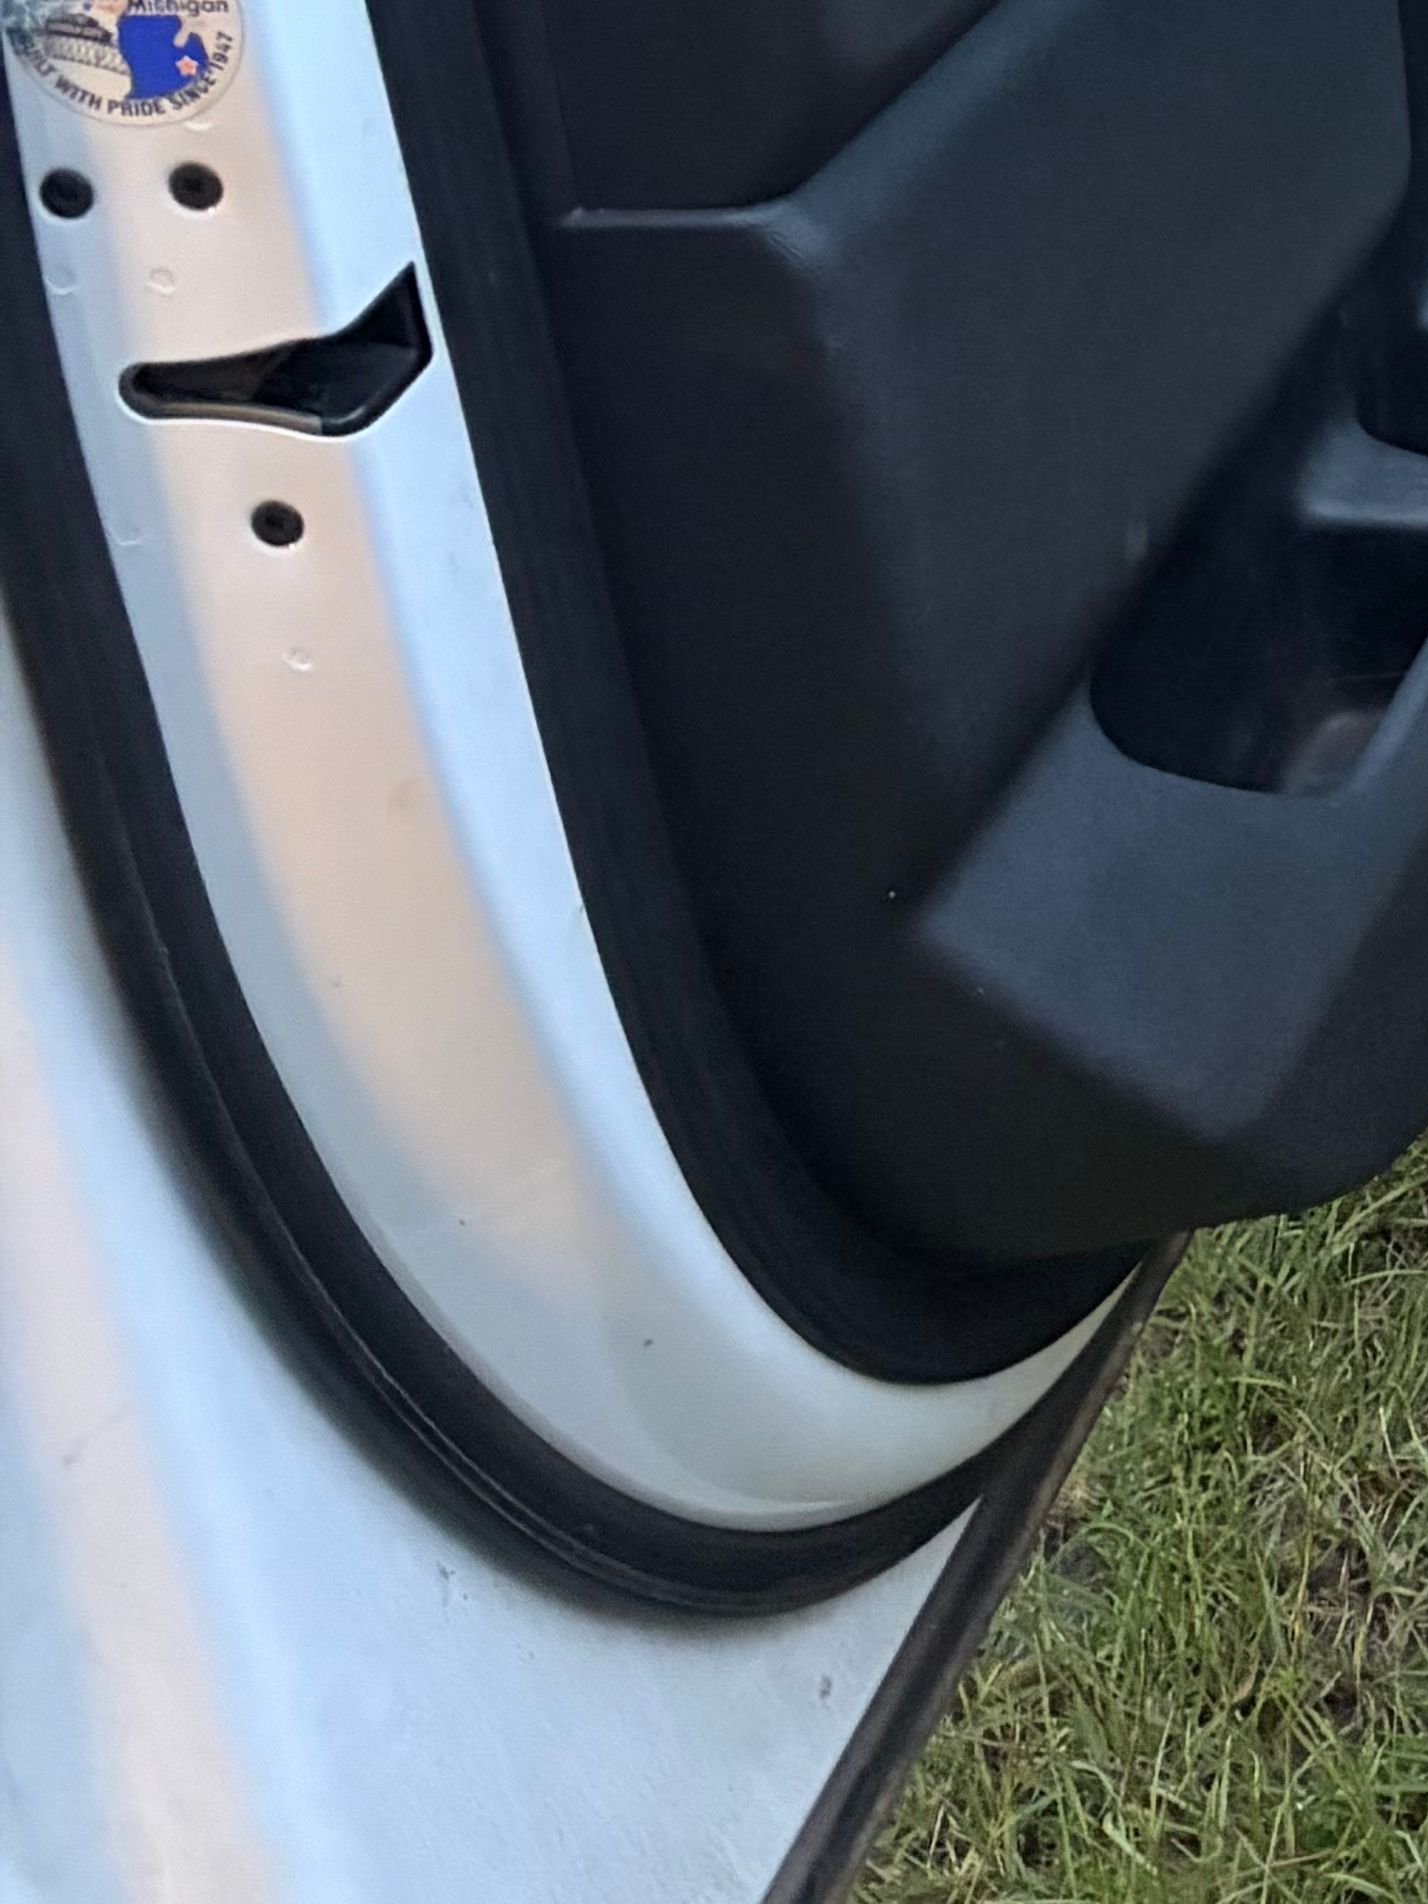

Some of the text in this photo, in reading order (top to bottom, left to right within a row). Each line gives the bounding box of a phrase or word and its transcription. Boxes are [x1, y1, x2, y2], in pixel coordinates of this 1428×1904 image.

[55, 74, 101, 110] WITH
[107, 98, 166, 117] PRIDE
[167, 69, 217, 110] SINCE
[208, 30, 233, 71] 1947
